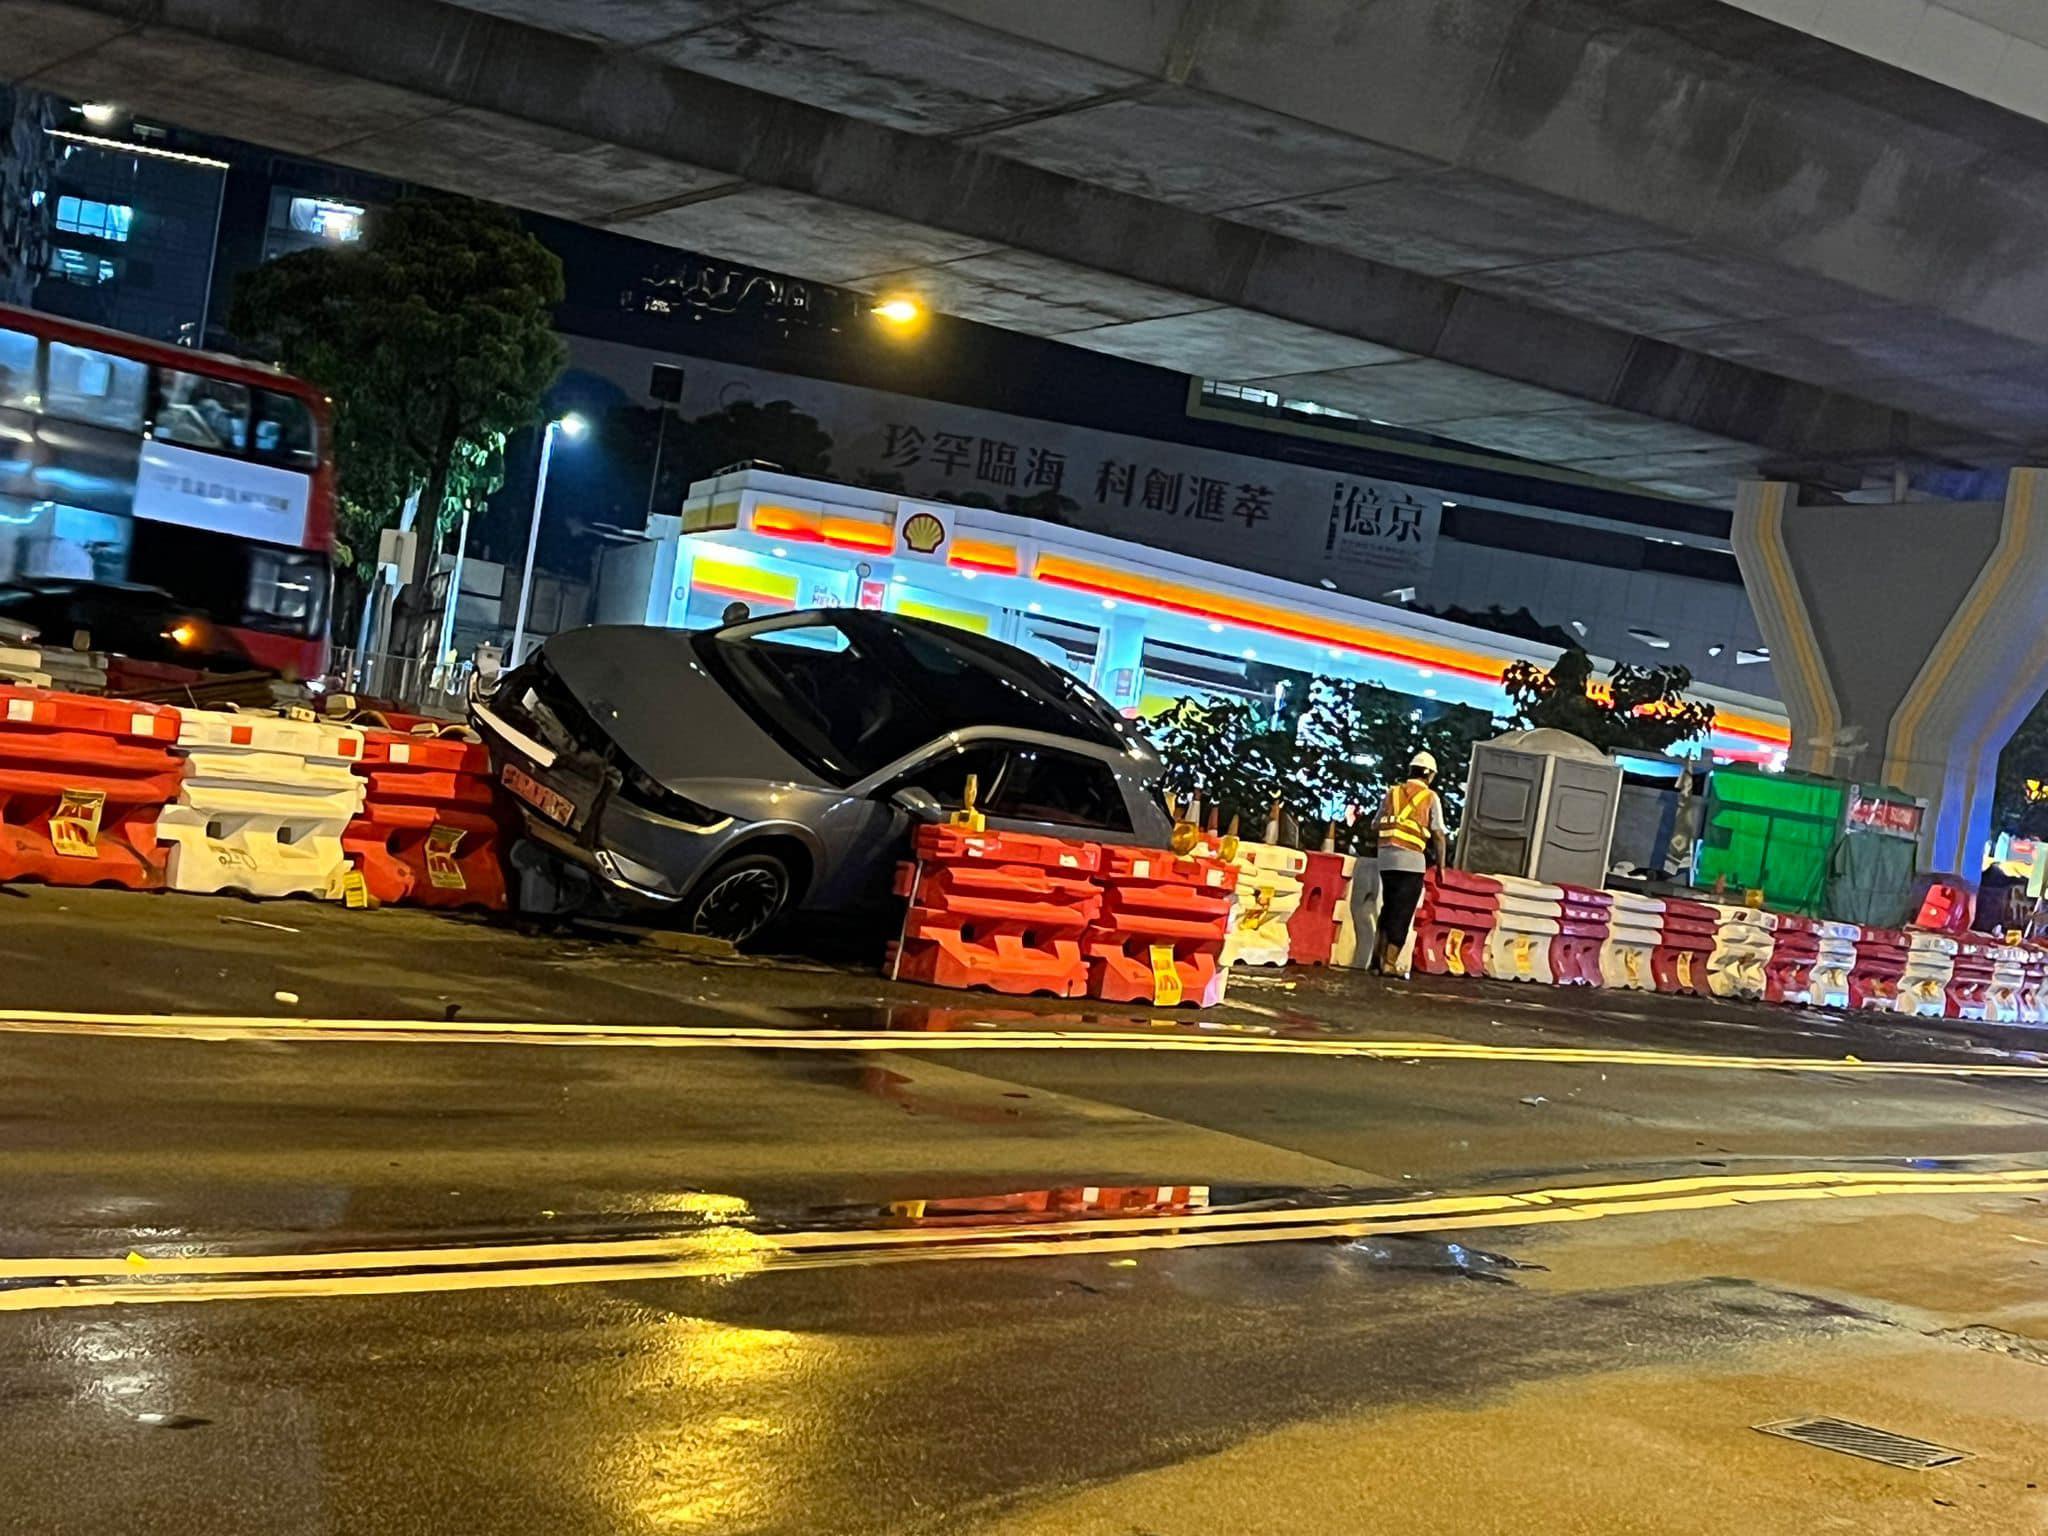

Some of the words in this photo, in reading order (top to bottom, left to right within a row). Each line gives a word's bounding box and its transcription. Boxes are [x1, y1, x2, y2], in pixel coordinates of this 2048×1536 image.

[882, 423, 1067, 491] 珍罕臨海
[1344, 486, 1428, 542] 億京
